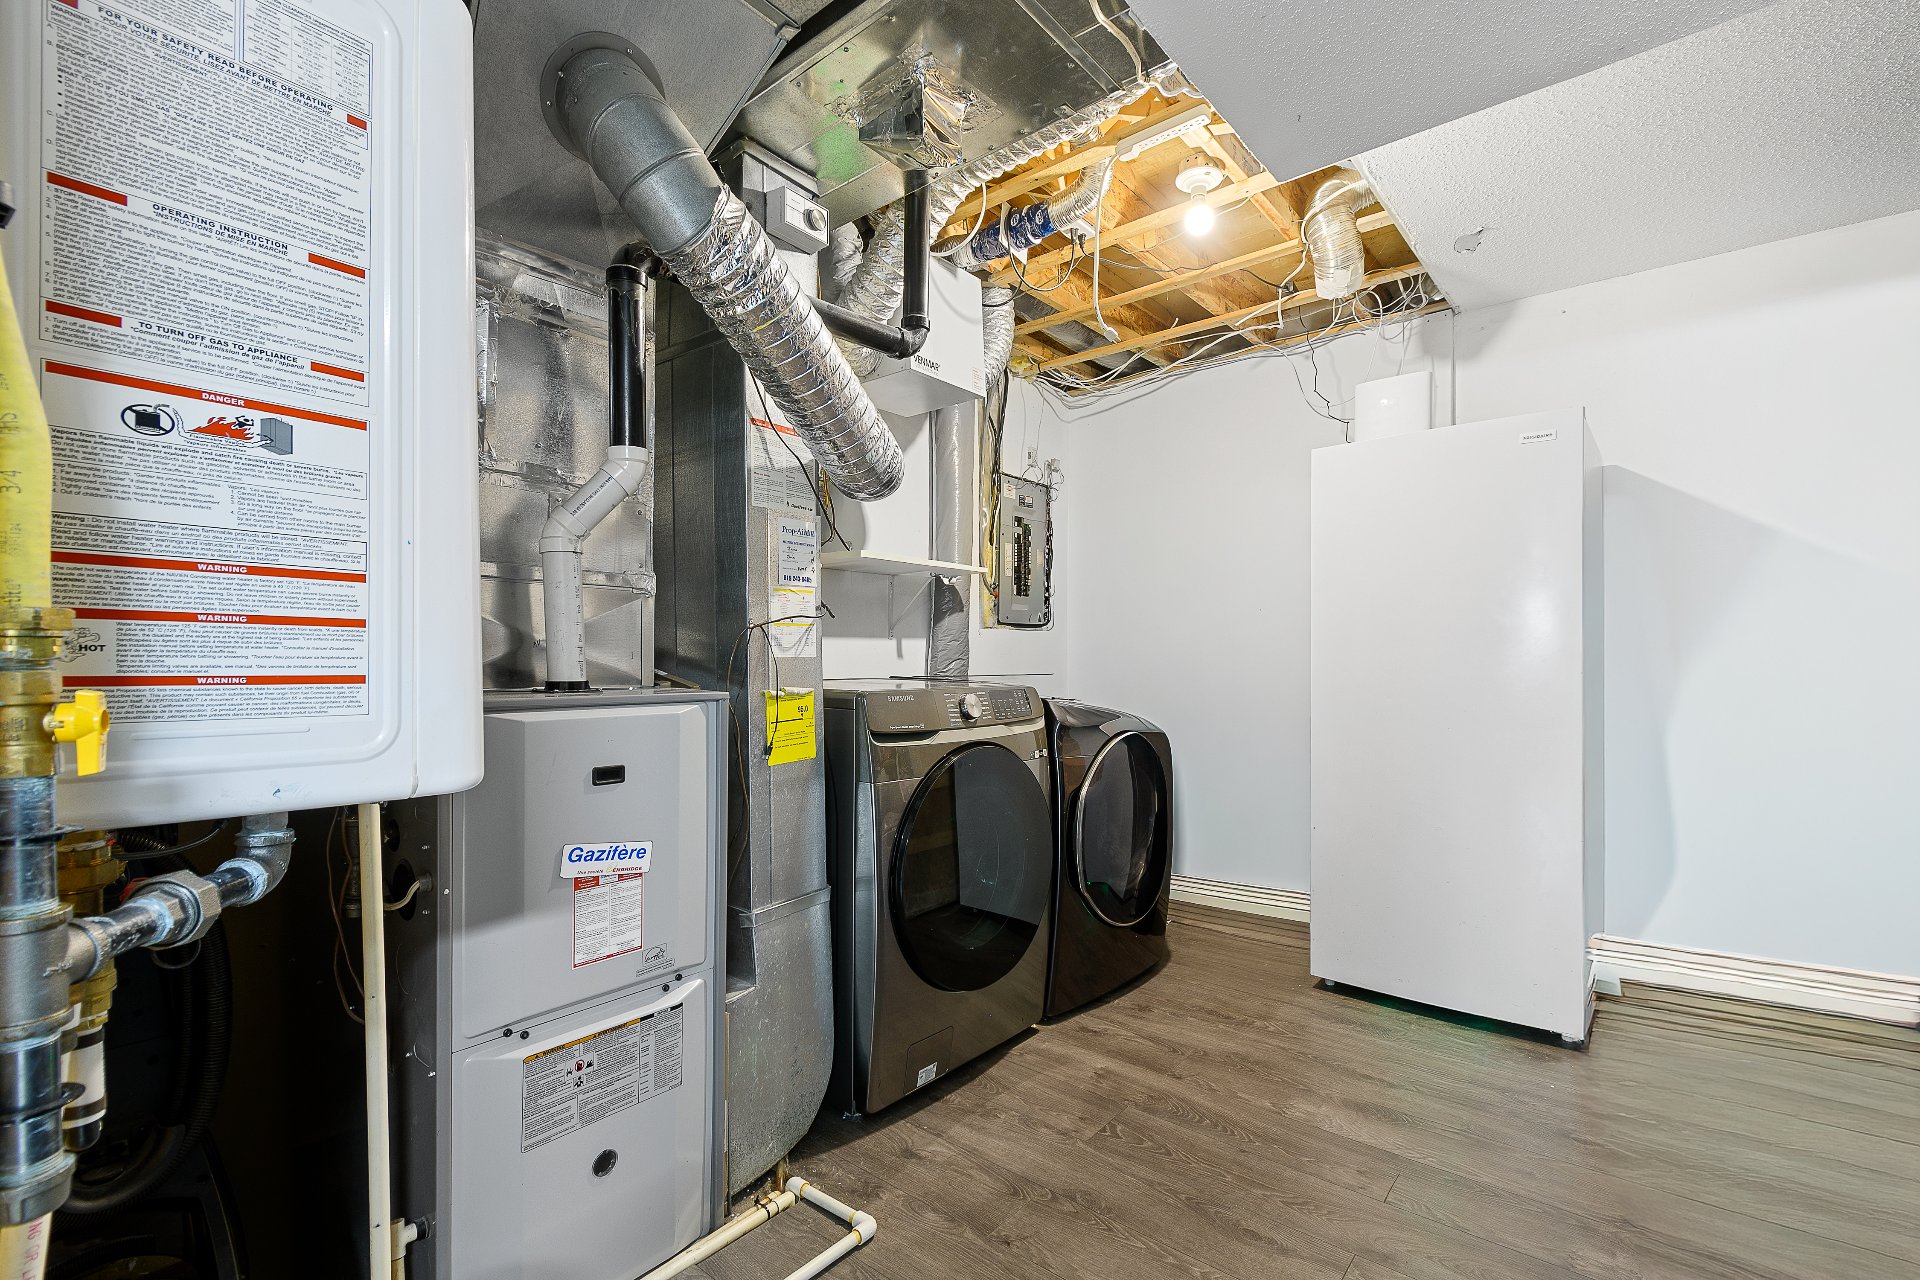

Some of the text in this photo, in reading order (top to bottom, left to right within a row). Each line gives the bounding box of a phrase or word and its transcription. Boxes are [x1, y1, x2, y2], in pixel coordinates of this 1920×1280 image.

[98, 6, 123, 22] FOR
[125, 17, 159, 38] YOUR
[161, 33, 205, 57] SAFETY
[207, 52, 236, 70] READ
[238, 65, 278, 88] BEFORE
[280, 83, 332, 111] OPERATING
[129, 26, 158, 45] VOTRE
[203, 57, 224, 72] LISEZ
[226, 67, 249, 83] AVANT
[262, 82, 290, 100] METTRE
[303, 99, 331, 117] MARCHE
[152, 203, 287, 250] OPERATING INSTRUCTION
[214, 228, 225, 237] DE
[227, 232, 244, 243] MISE
[246, 238, 256, 247] EN
[257, 242, 288, 256] MARCHE
[139, 321, 297, 363] TO TURN OFF GAS TO APPLIANCE
[171, 335, 198, 346] couper
[199, 341, 239, 356] l'admission
[251, 353, 263, 361] gaz
[274, 358, 304, 370] l'appareil
[201, 392, 244, 406] DANGER
[51, 427, 77, 436] Vapors
[79, 431, 96, 439] from
[98, 434, 134, 445] flammable
[136, 440, 159, 448] liquids
[173, 445, 199, 454] explode
[244, 456, 267, 464] causing
[189, 433, 223, 443] Flammable
[117, 448, 151, 458] flammable
[152, 453, 179, 462] products
[52, 513, 84, 522] Warning
[116, 519, 136, 527] install
[137, 521, 156, 529] water
[158, 523, 178, 531] heater
[201, 527, 233, 535] flammable
[197, 563, 246, 572] WARNING
[197, 614, 246, 622] WARNING
[887, 694, 915, 702] SAMSUNG
[568, 844, 647, 863] Gazifère
